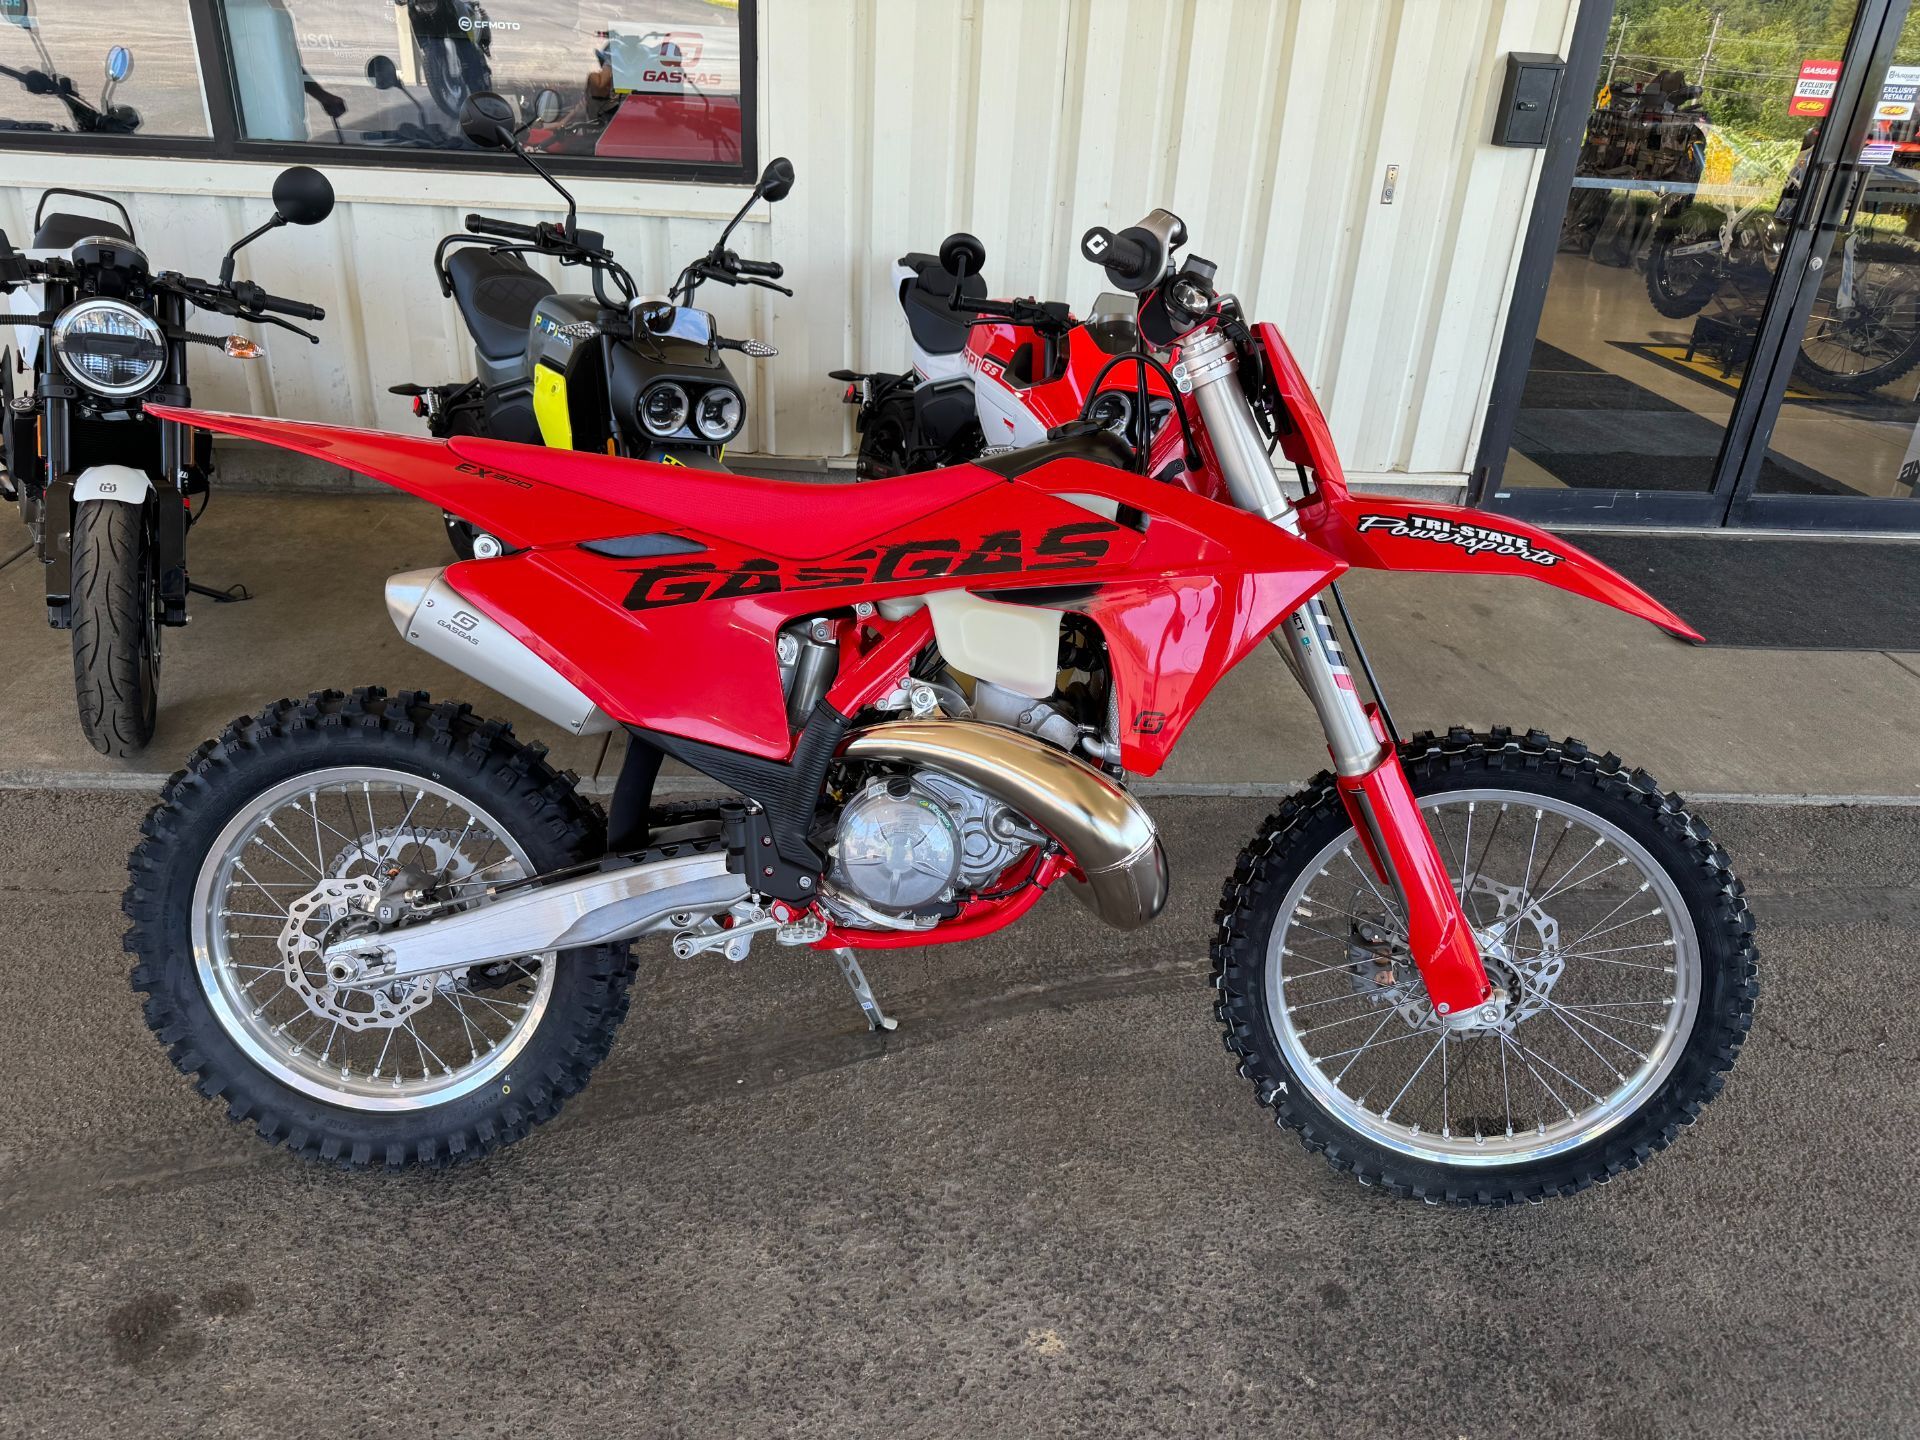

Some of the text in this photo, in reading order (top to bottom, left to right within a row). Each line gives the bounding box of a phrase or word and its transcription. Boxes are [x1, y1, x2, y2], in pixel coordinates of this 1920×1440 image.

[474, 20, 521, 31] CFMOTO
[642, 70, 722, 85] GASGAS
[1803, 67, 1838, 75] GASGAS
[1800, 81, 1834, 90] EXCLUSIVE
[1800, 88, 1829, 96] RETAILER
[1883, 86, 1917, 94] EXCLUSIVE
[1883, 93, 1913, 101] RETAILER
[983, 362, 999, 377] SS
[1411, 516, 1529, 549] TRI-STATE
[1358, 515, 1566, 566] Powersports
[616, 521, 1121, 612] GASGAS
[437, 619, 480, 646] GASGAS
